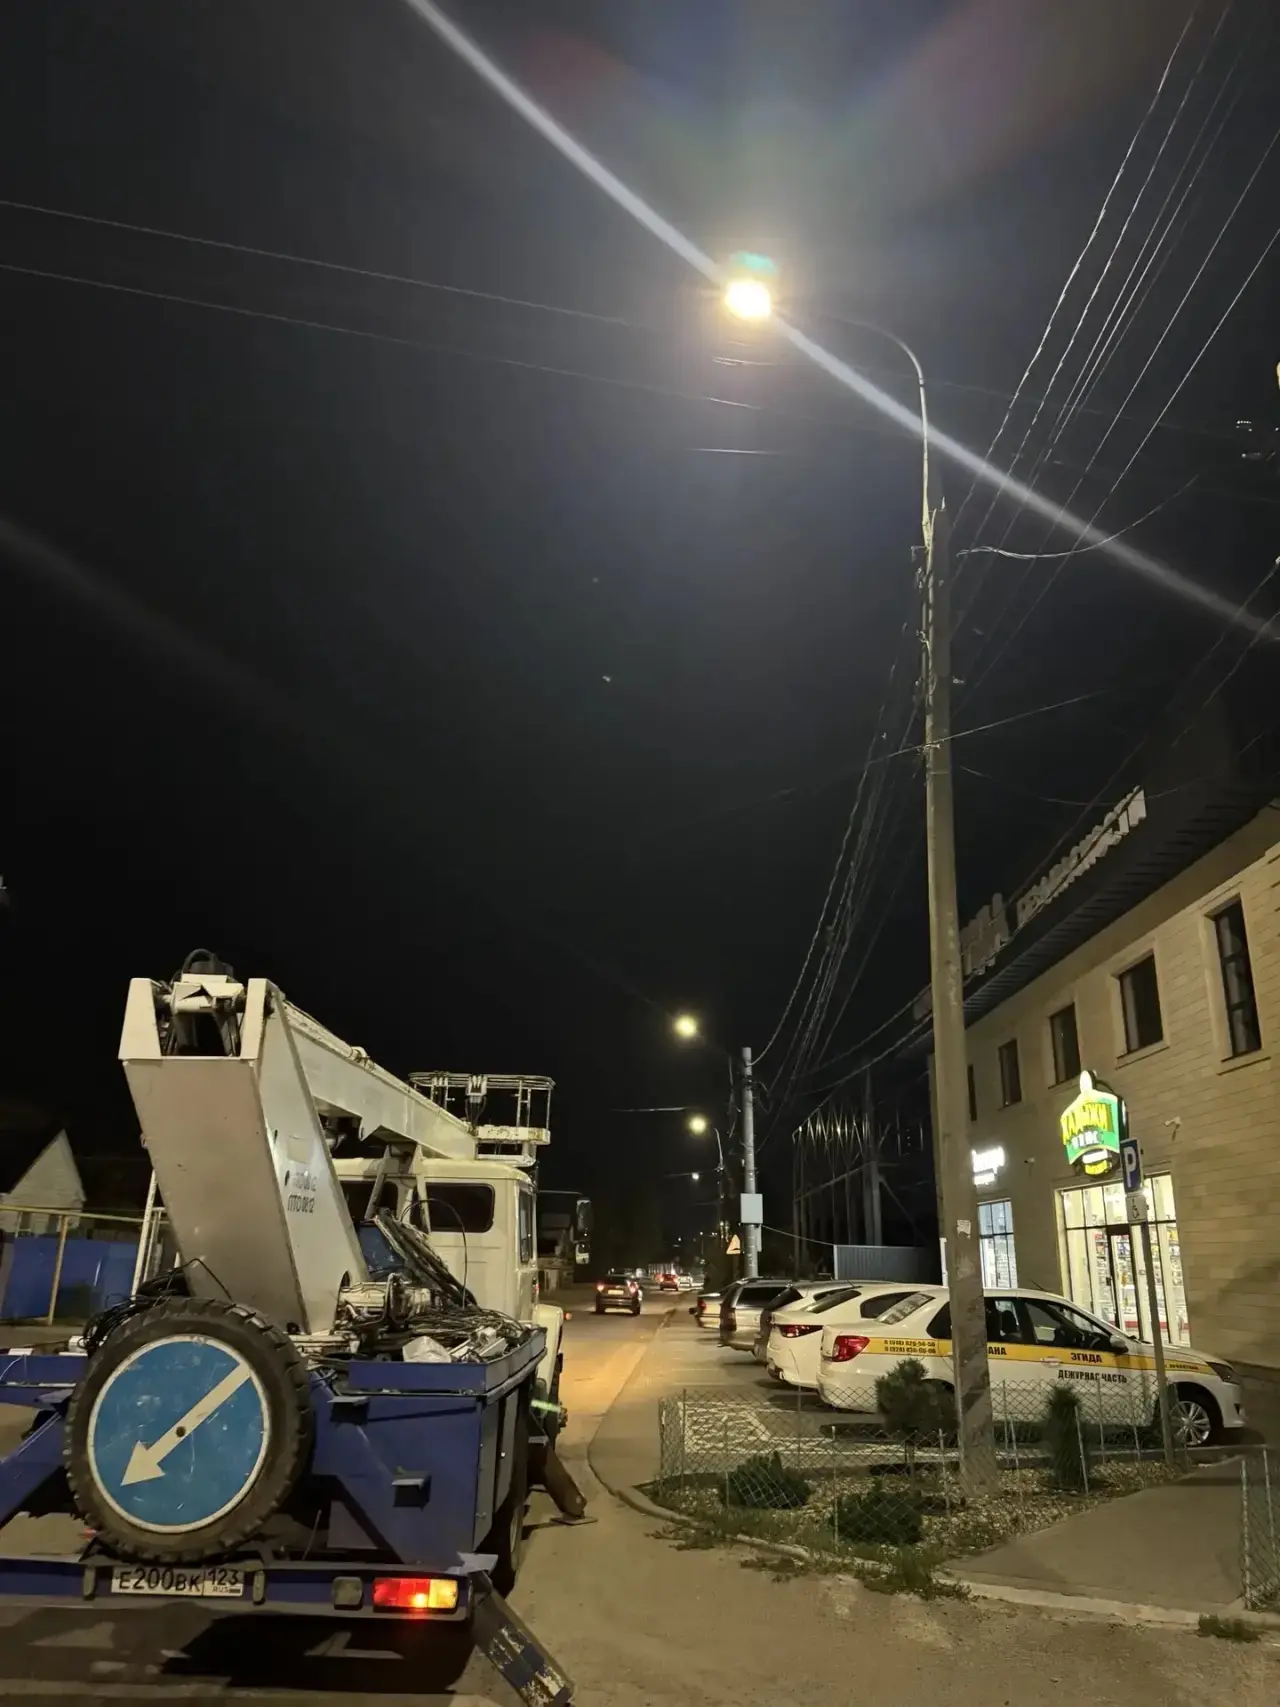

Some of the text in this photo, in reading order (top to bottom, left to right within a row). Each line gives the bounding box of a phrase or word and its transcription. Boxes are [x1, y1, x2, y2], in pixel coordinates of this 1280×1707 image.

[1123, 1146, 1136, 1187] P
[1070, 1352, 1102, 1363] ЭГИДА
[1101, 1372, 1127, 1384] ЧАСТЬ
[207, 1567, 239, 1586] 123
